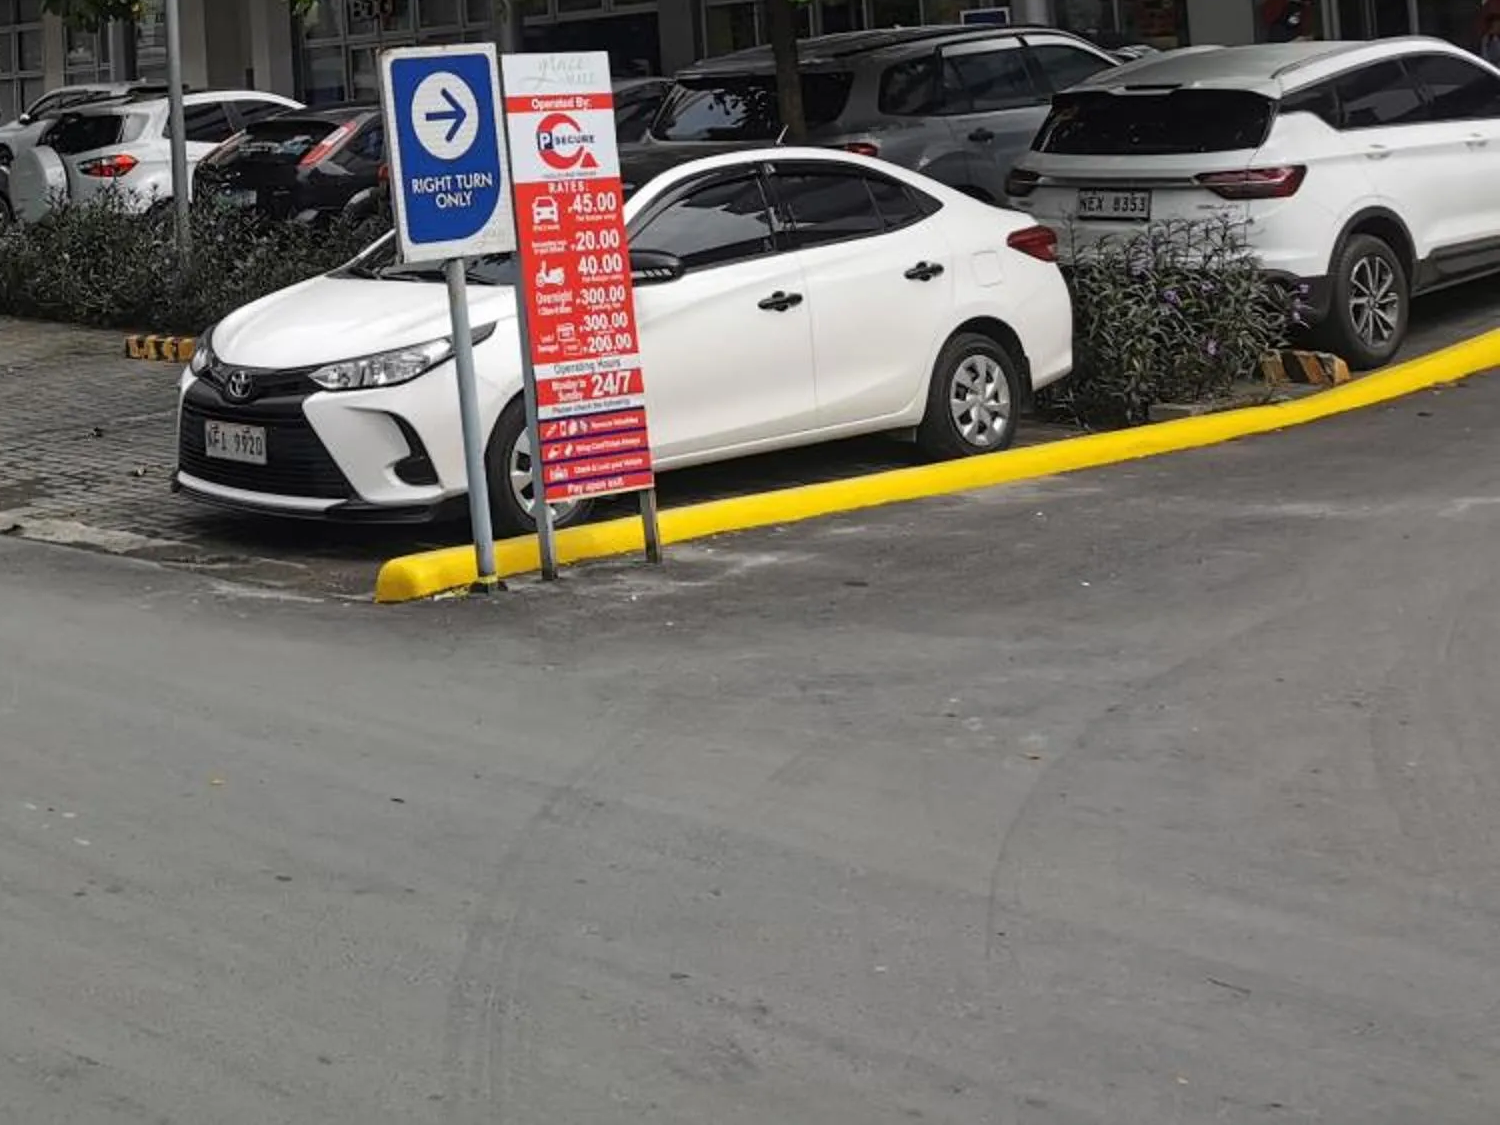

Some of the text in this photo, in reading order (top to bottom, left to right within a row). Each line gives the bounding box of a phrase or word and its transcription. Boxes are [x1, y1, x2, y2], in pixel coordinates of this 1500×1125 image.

[531, 97, 574, 111] Operated
[554, 134, 596, 145] SECURE
[411, 172, 493, 193] RIGHT TURN
[435, 191, 472, 208] ONLY
[577, 253, 623, 275] 40.00
[554, 361, 596, 375] Operating
[591, 371, 631, 397] 24/7
